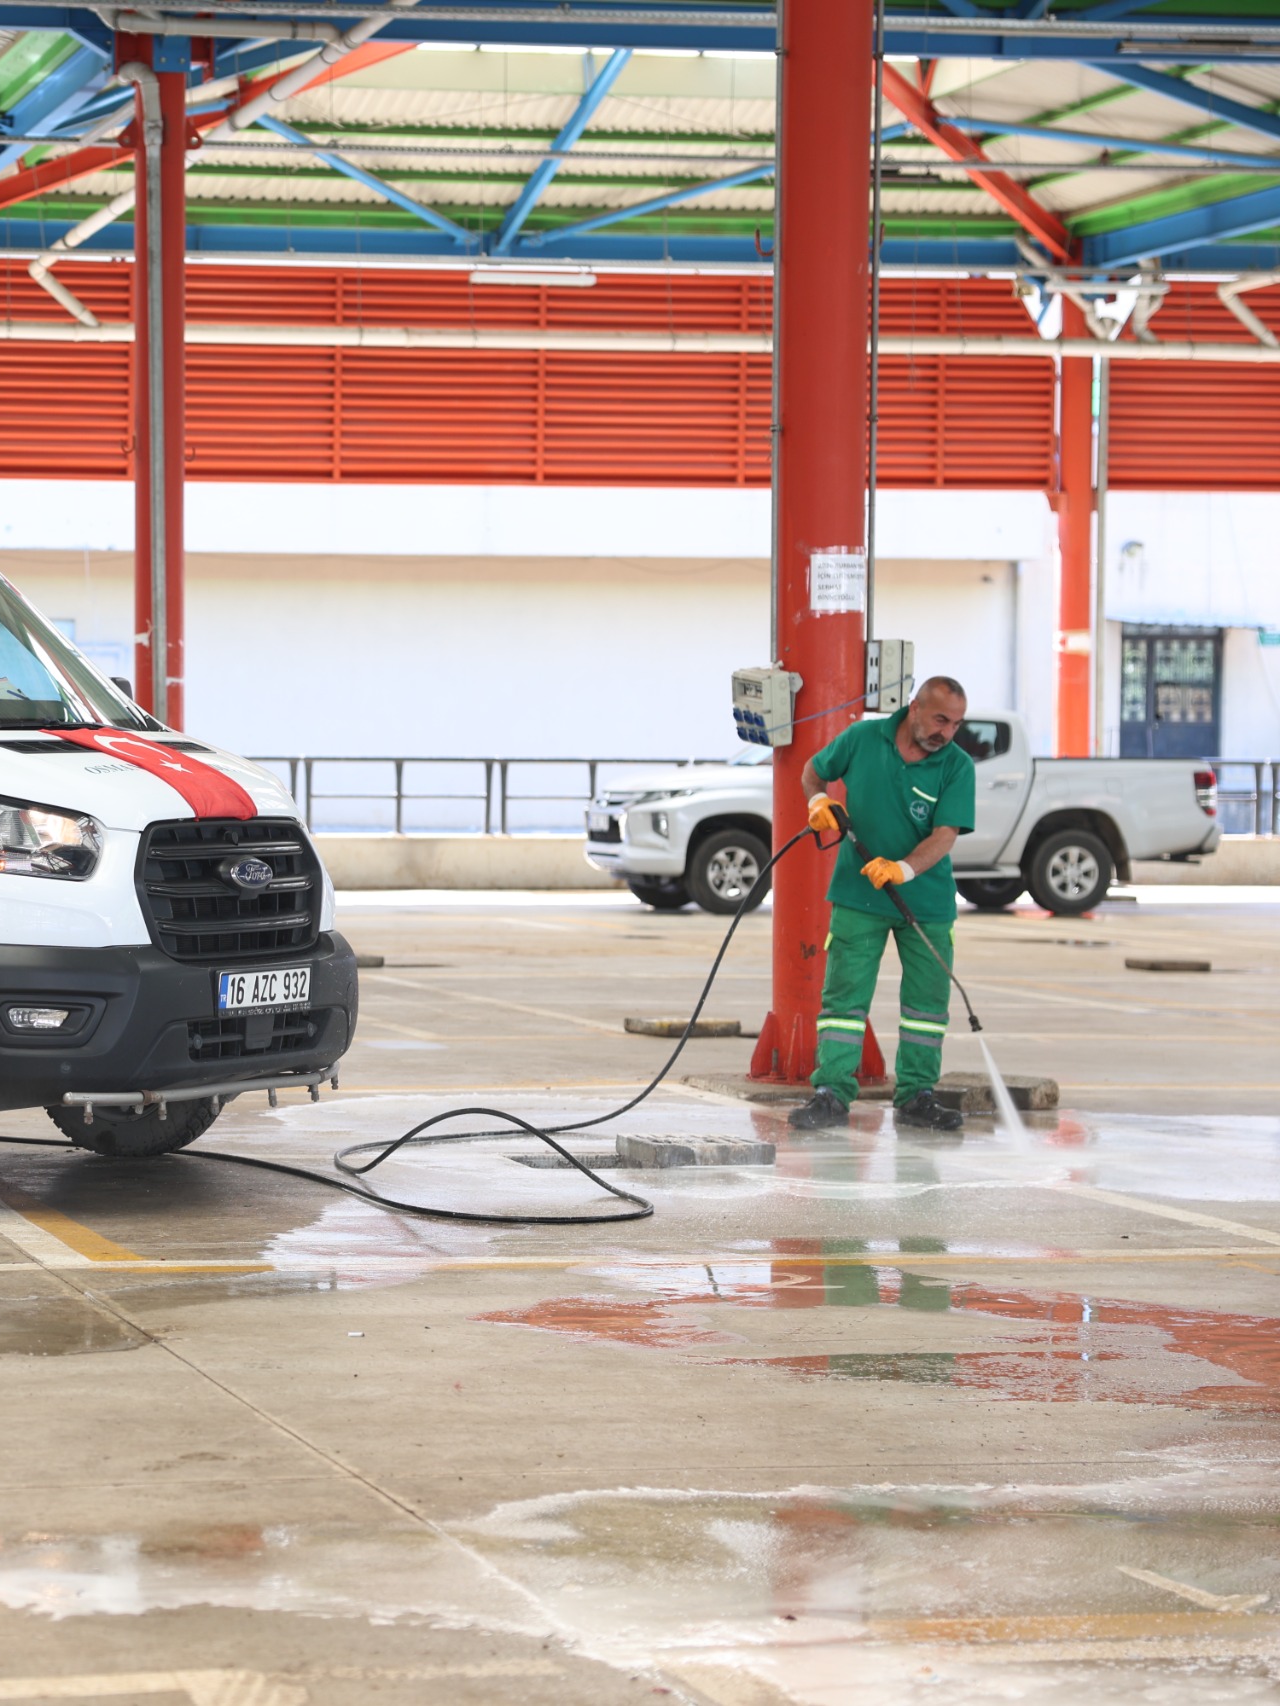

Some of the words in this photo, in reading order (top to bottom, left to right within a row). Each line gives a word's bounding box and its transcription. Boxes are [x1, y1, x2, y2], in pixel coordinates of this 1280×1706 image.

[245, 863, 268, 881] Ford
[230, 976, 246, 1005] 16
[251, 973, 277, 1004] AZC
[283, 970, 307, 1000] 932
